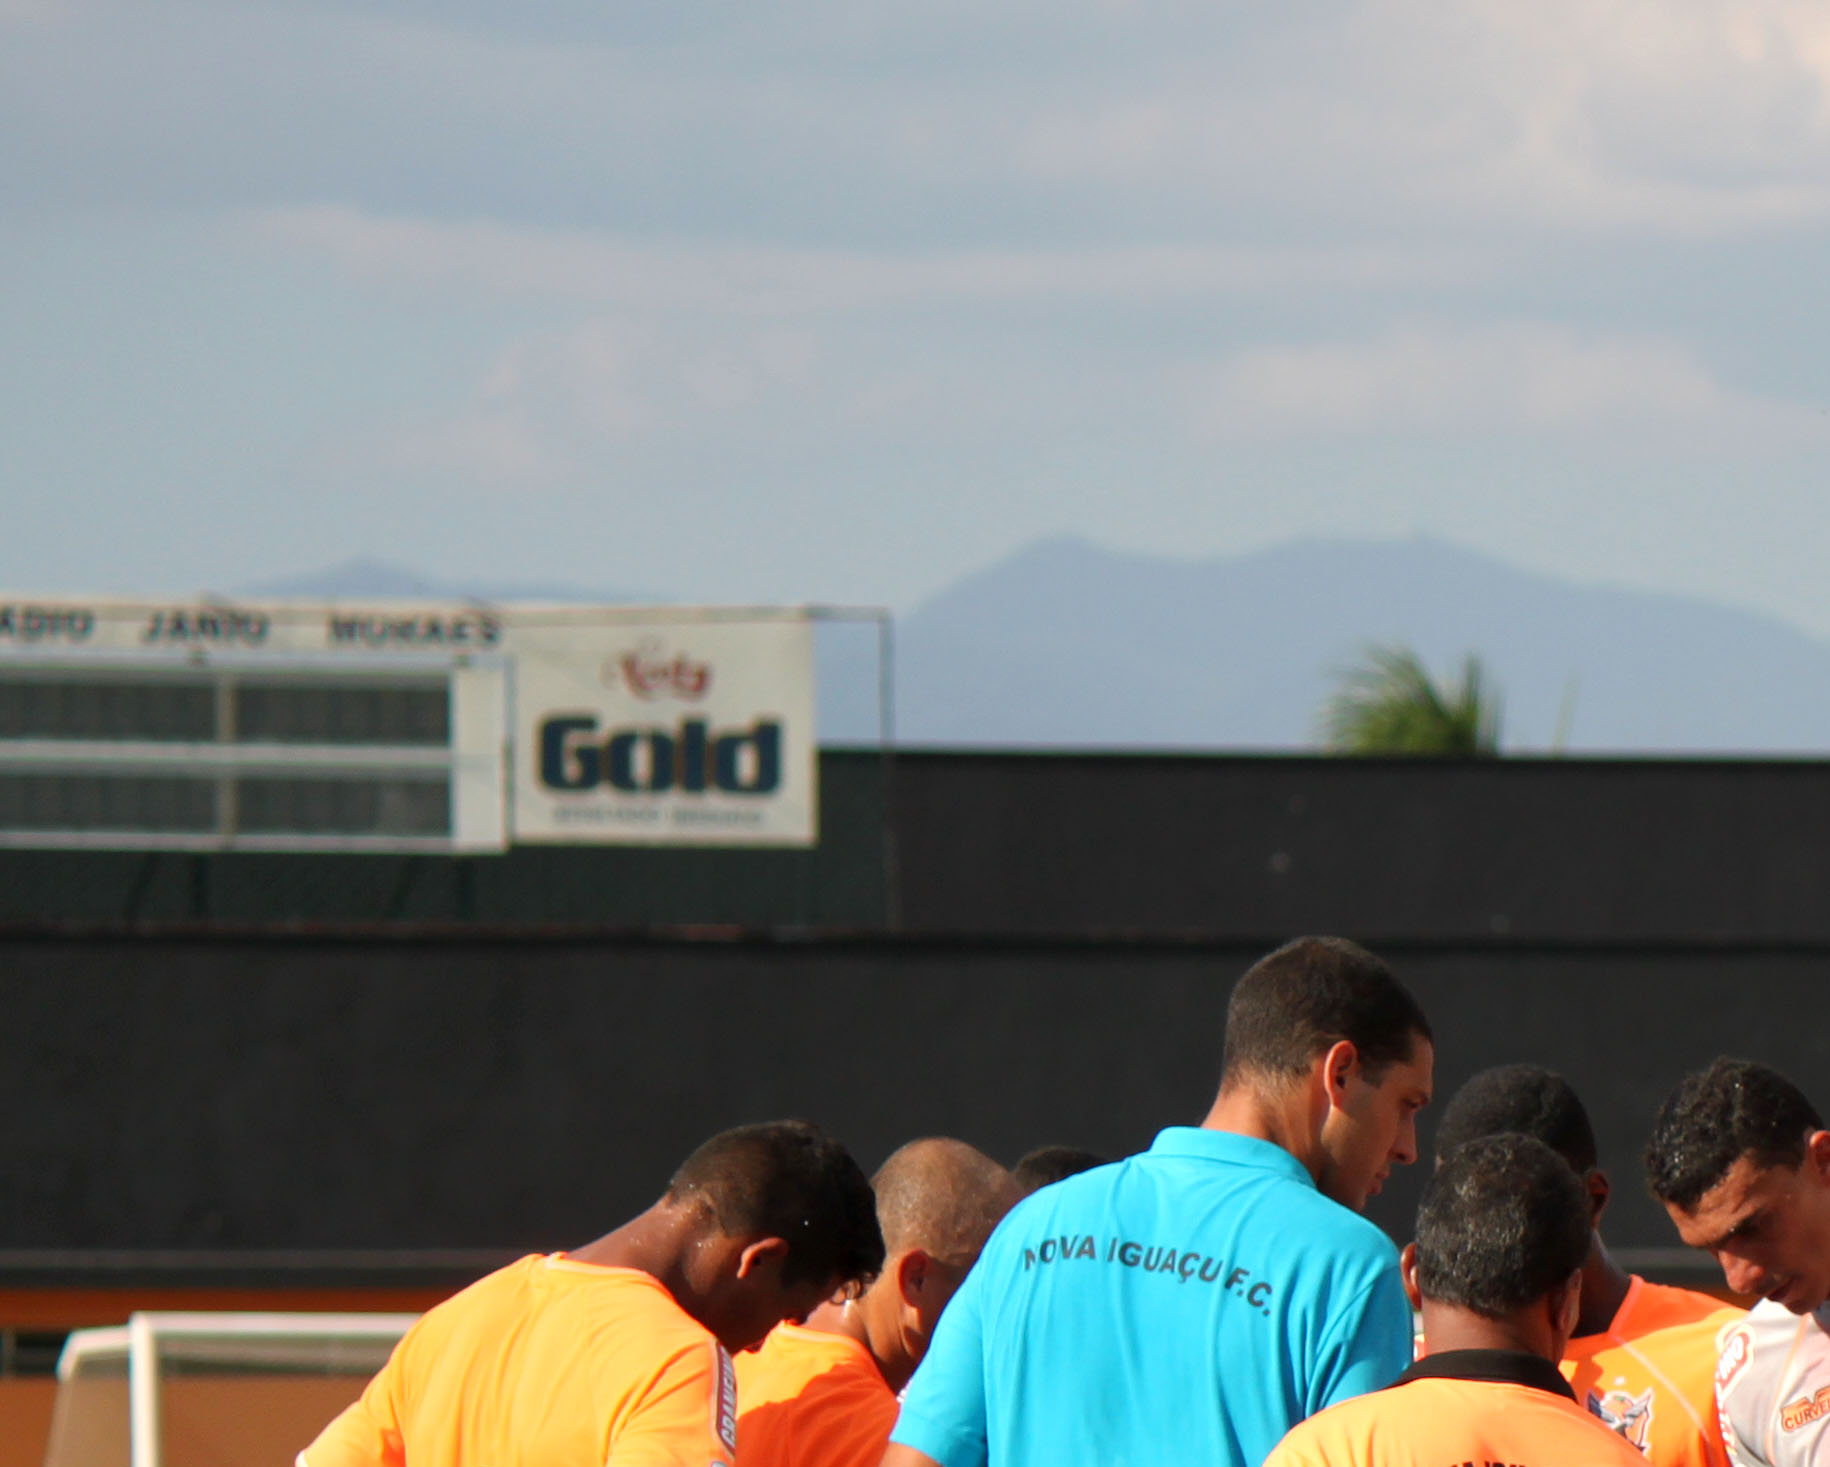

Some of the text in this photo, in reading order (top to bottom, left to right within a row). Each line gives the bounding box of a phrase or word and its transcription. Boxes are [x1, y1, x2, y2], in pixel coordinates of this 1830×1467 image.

[540, 715, 781, 793] Gold
[1024, 1234, 1272, 1317] NOVA IGUAÇU F.C.
